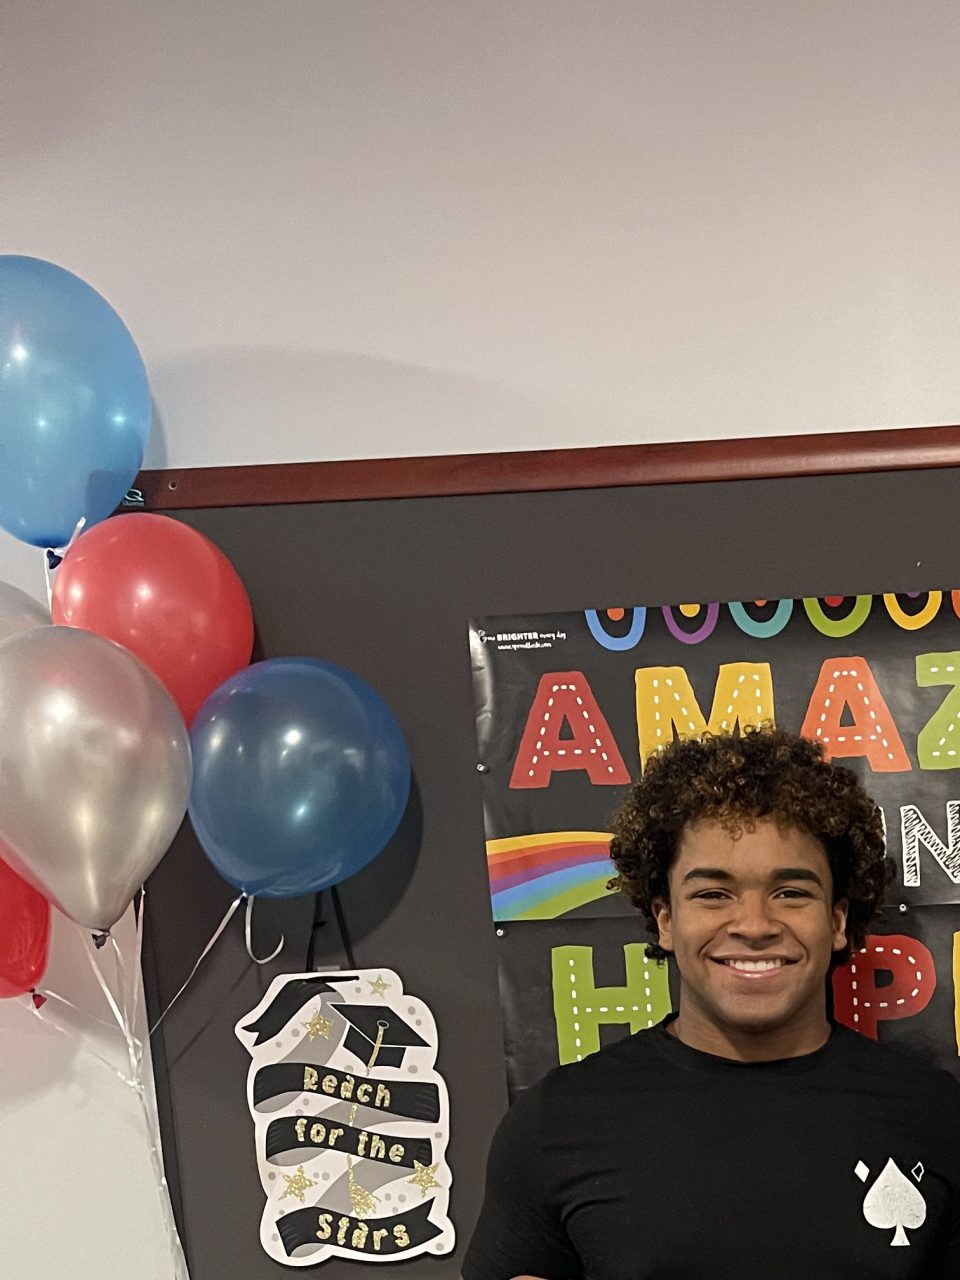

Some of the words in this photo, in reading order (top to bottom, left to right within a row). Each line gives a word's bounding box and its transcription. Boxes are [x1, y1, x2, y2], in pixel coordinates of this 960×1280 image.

[496, 632, 538, 641] BRIGHTER
[303, 1066, 391, 1108] Reach
[294, 1117, 345, 1147] for
[357, 1131, 405, 1163] the
[316, 1212, 411, 1251] Stars
